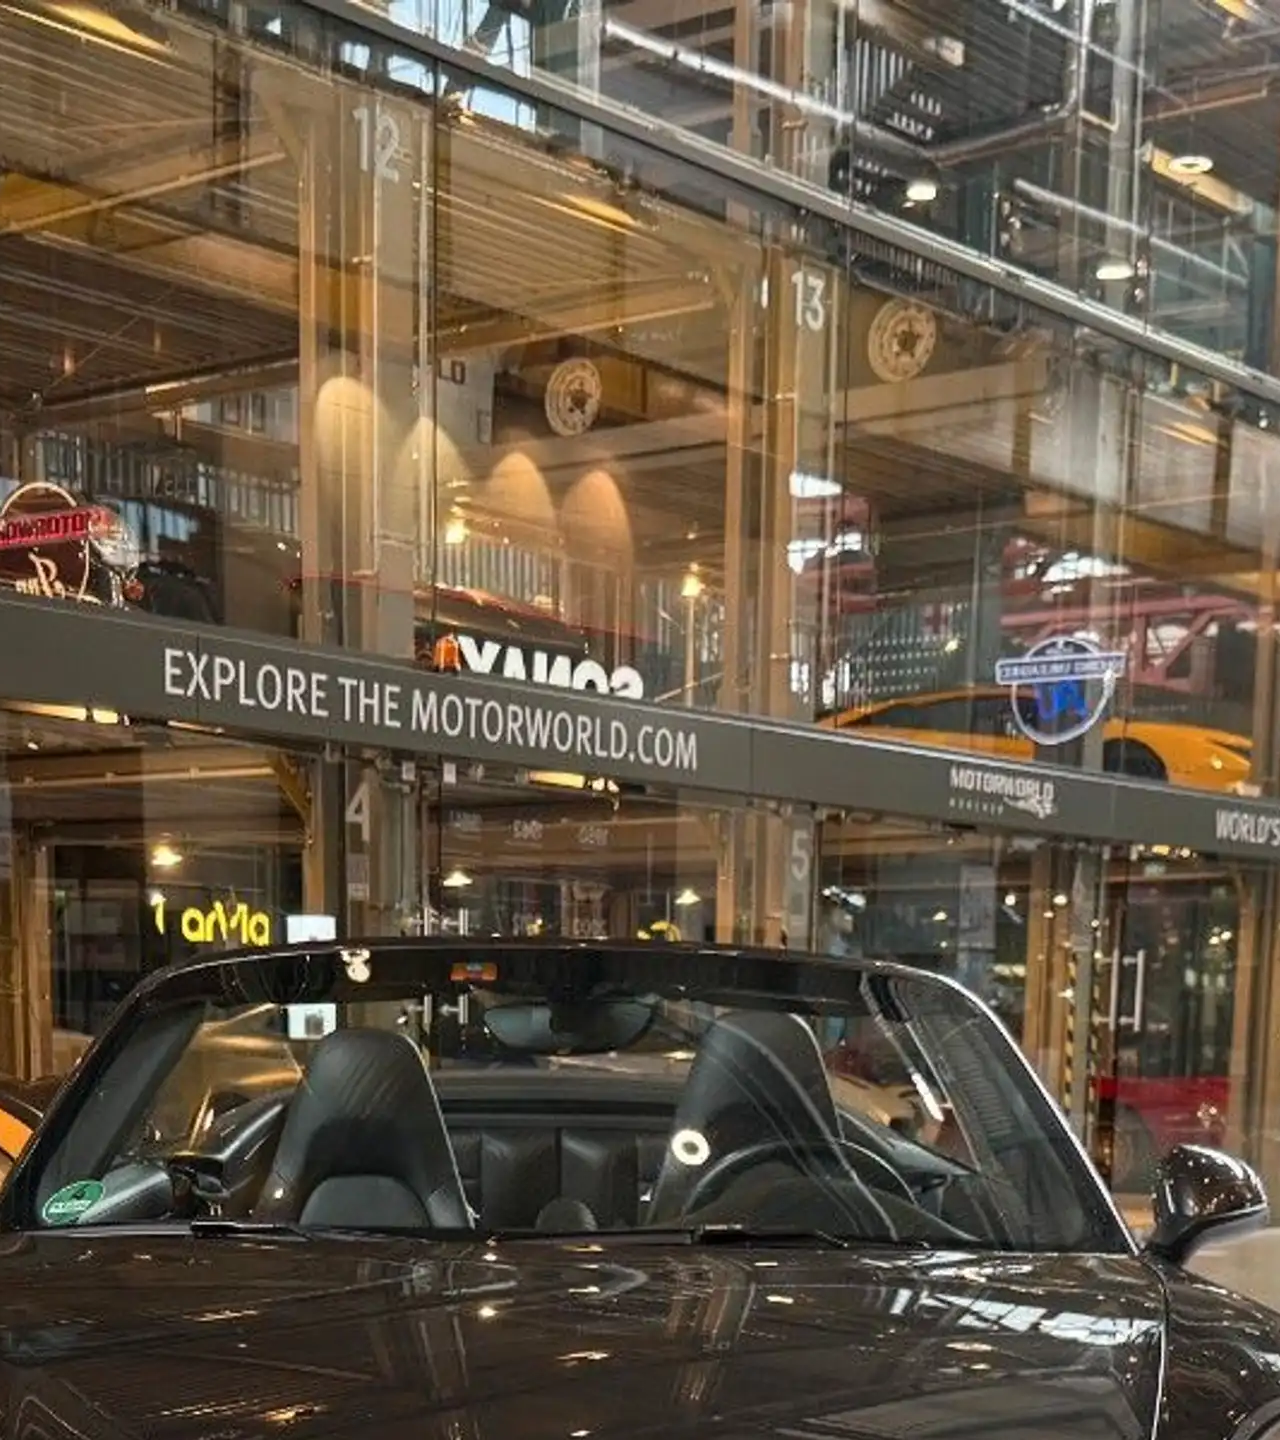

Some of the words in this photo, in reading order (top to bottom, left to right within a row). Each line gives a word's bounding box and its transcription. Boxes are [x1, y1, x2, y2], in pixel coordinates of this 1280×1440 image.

[352, 107, 400, 183] 12
[791, 271, 824, 331] 13
[163, 647, 329, 718] EXPLORE
[337, 675, 401, 730] THE
[411, 689, 697, 770] MOTORWORLD.COM
[345, 781, 370, 841] 4
[950, 766, 1054, 801] MOTORWORLD
[791, 829, 810, 881] 5
